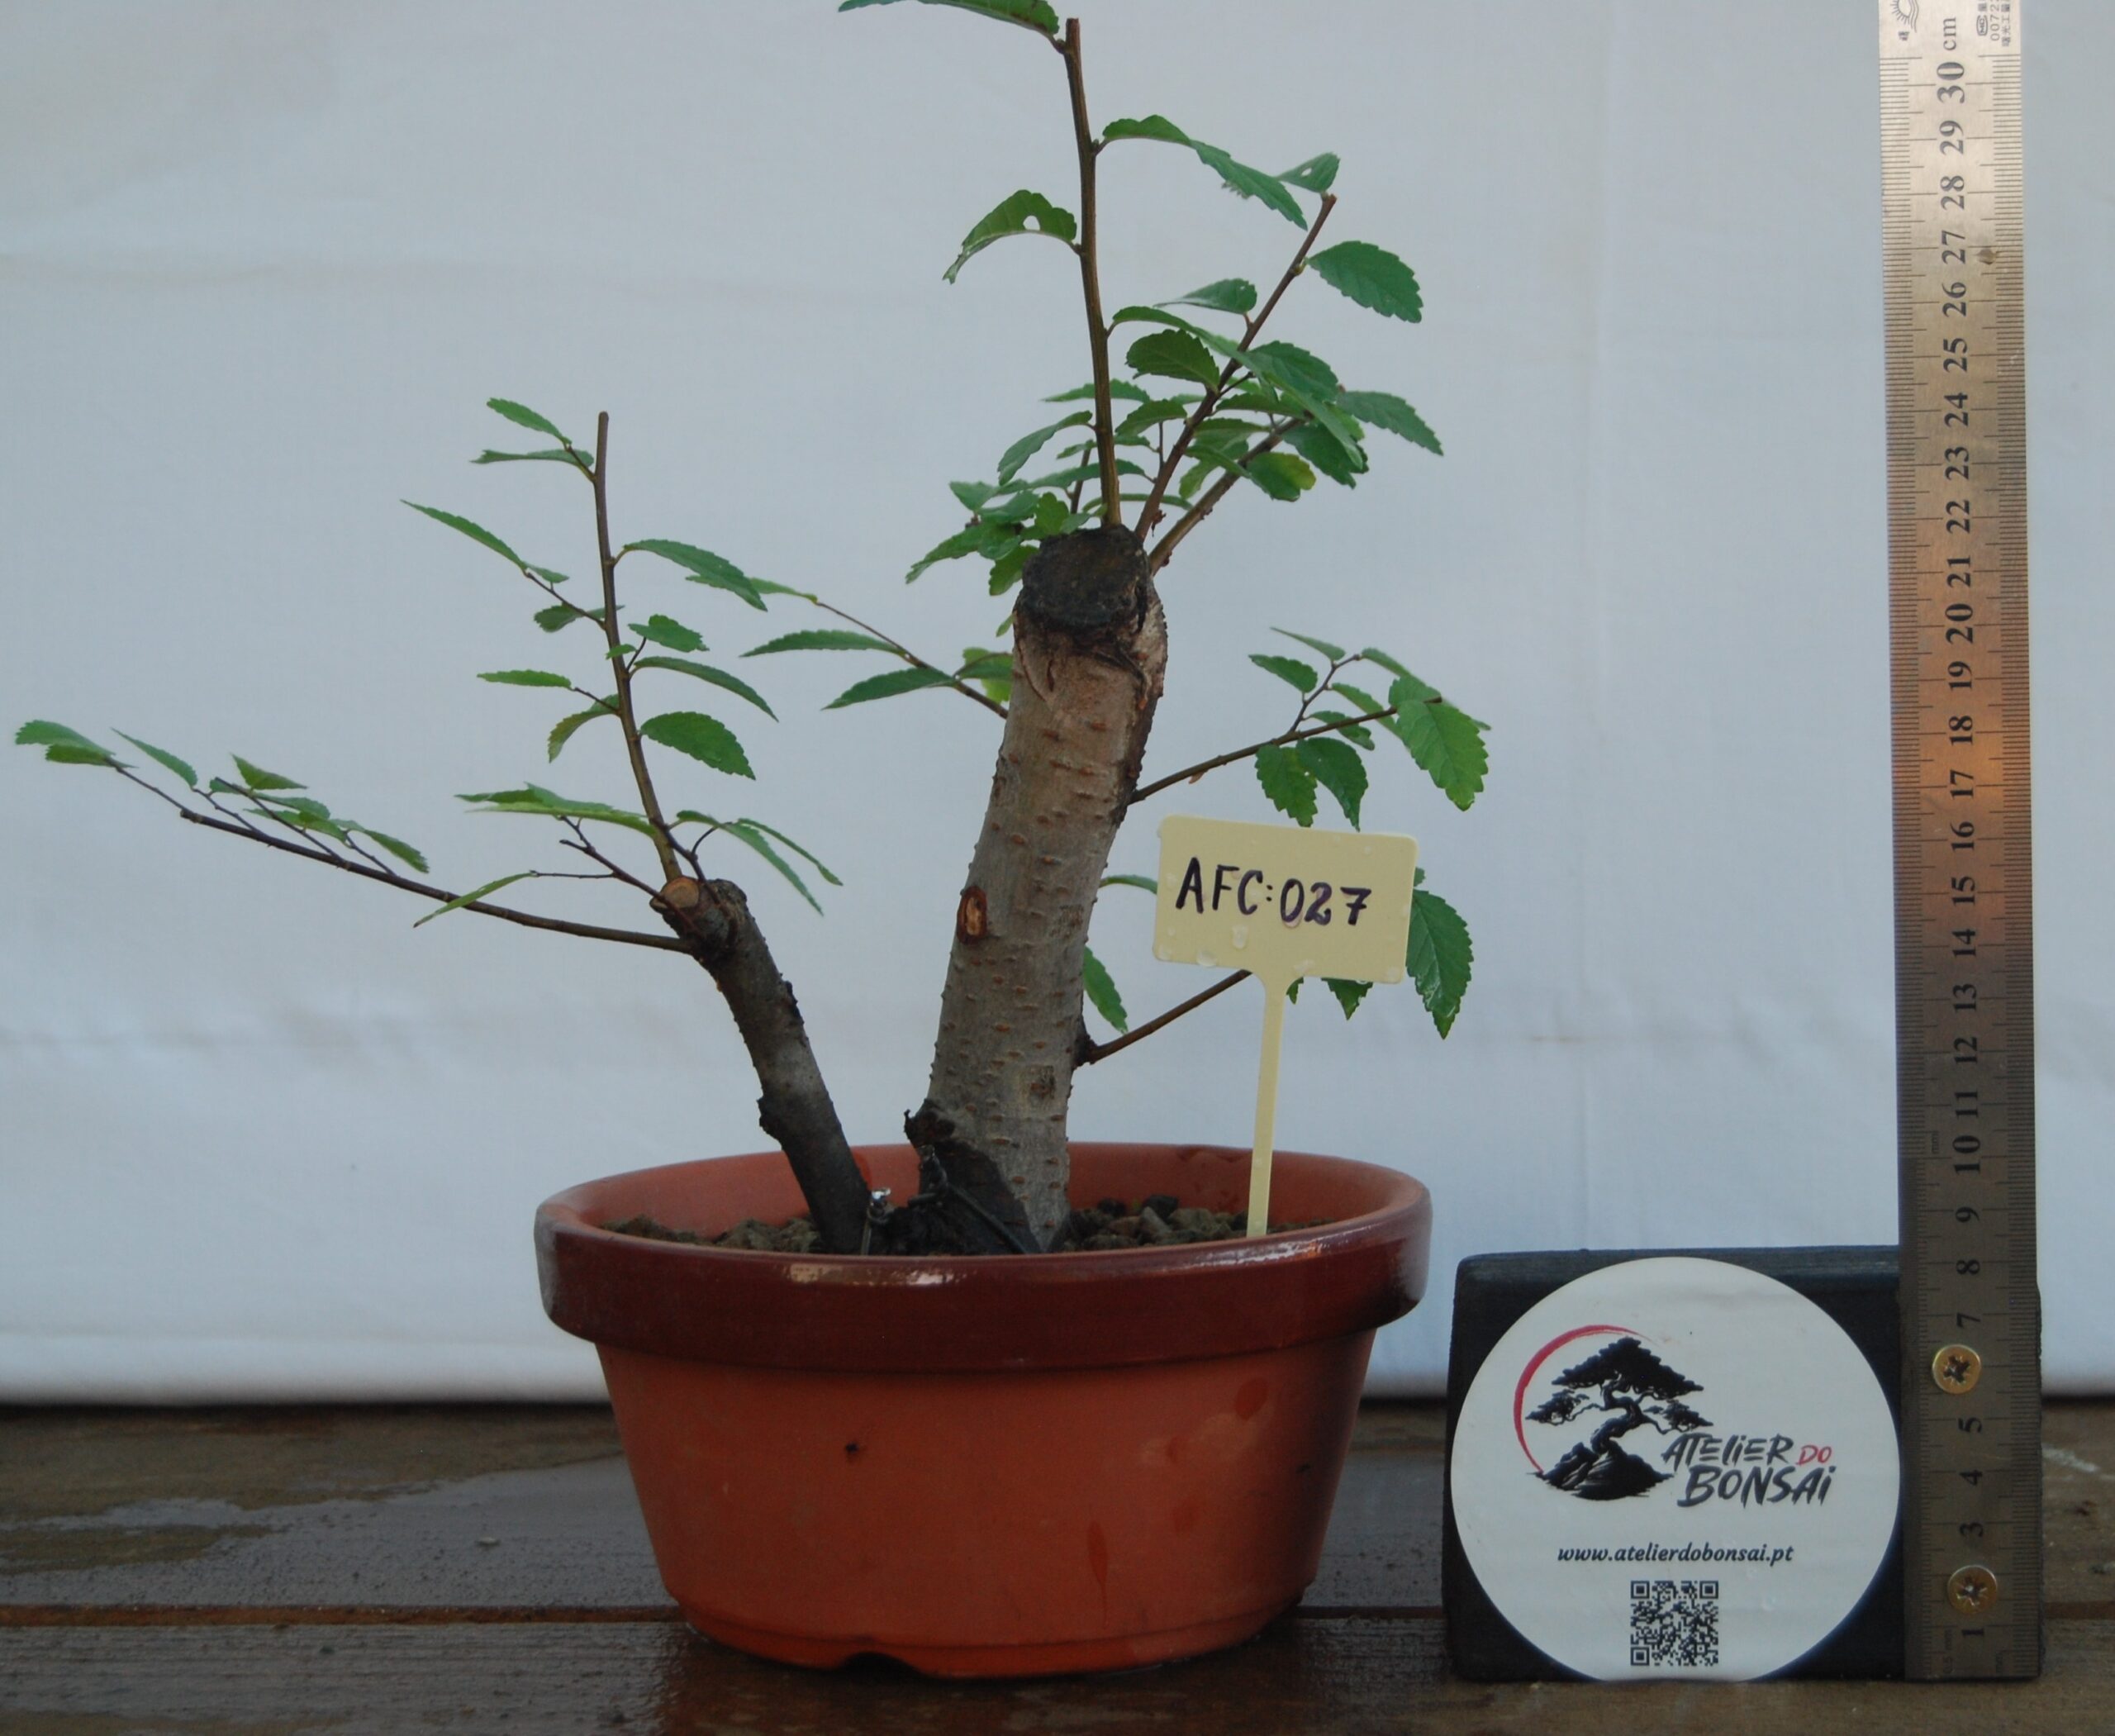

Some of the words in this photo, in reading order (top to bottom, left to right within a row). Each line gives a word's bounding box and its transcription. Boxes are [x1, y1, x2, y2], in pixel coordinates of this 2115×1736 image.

[1942, 17, 1957, 51] cm
[1990, 0, 2000, 41] 0072
[1937, 62, 1965, 103] 30
[1939, 120, 1964, 155] 29
[1941, 175, 1965, 210] 28
[1942, 231, 1966, 264] 27
[1942, 282, 1967, 316] 26
[1943, 338, 1968, 373] 25
[1944, 392, 1969, 426] 24
[1945, 446, 1970, 480] 23
[1946, 500, 1970, 534] 22
[1946, 555, 1970, 587] 21
[1945, 603, 1974, 644] 20
[1948, 661, 1973, 690] 19
[1948, 716, 1974, 745] 18
[1950, 769, 1974, 799] 17
[1951, 821, 1975, 852] 16
[1951, 876, 1975, 906] 15
[1952, 929, 1976, 957] 14
[1952, 983, 1977, 1011] 13
[1954, 1036, 1977, 1064] 12
[1955, 1091, 1979, 1119] 11
[1952, 1135, 1981, 1175] 10
[1956, 1206, 1980, 1223] 9
[1956, 1259, 1980, 1275] 8
[1956, 1312, 1981, 1329] 7
[1958, 1417, 1982, 1433] 5
[1796, 1444, 1832, 1467] DO
[1959, 1470, 1983, 1486] 4
[1959, 1522, 1983, 1537] 3
[1557, 1542, 1794, 1567] www.atelierdobonsai.pt
[1961, 1629, 1984, 1638] 1
